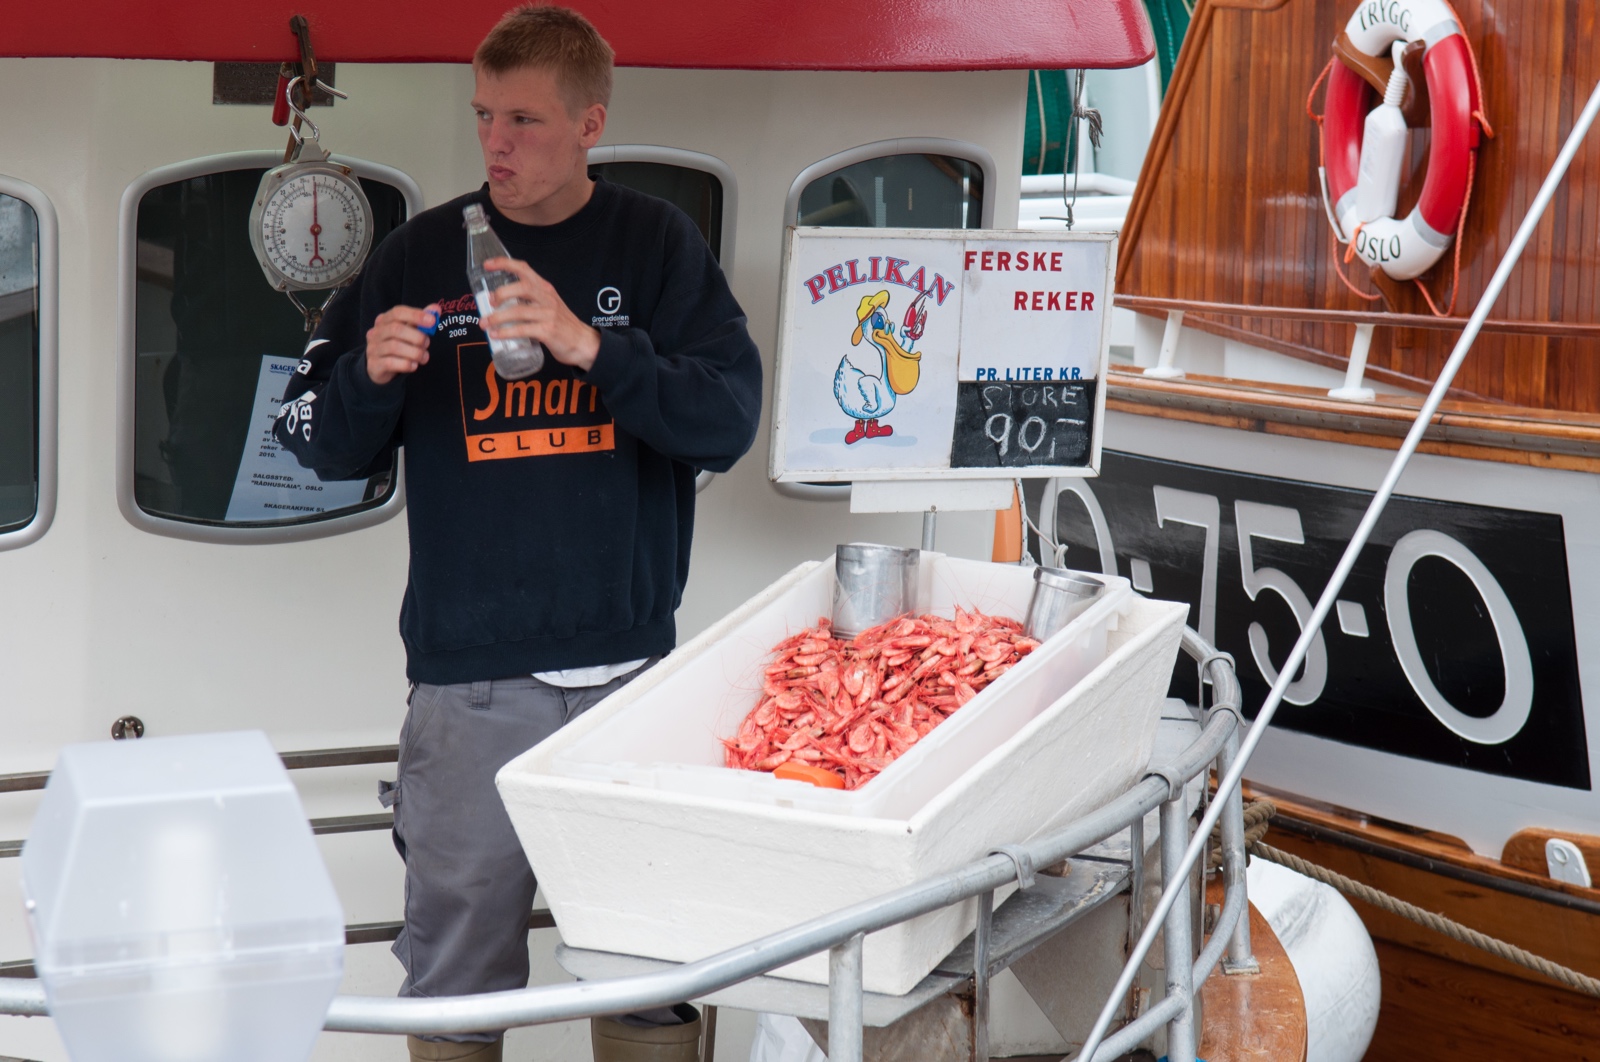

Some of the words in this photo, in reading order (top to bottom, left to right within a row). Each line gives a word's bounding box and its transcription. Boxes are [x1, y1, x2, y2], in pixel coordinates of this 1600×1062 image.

[1357, 0, 1411, 33] TRYGG
[1356, 229, 1401, 262] OSLO
[964, 251, 1063, 272] FERSKE
[804, 256, 955, 306] PELIKAN
[1013, 291, 1095, 311] REKER
[437, 314, 480, 331] svingen
[448, 327, 468, 338] 2005
[270, 363, 296, 372] SKAGER
[975, 367, 1001, 382] PR.
[1005, 367, 1053, 381] LITER
[1059, 367, 1084, 381] KR.
[981, 384, 1085, 409] STORE
[478, 429, 602, 453] CLUB
